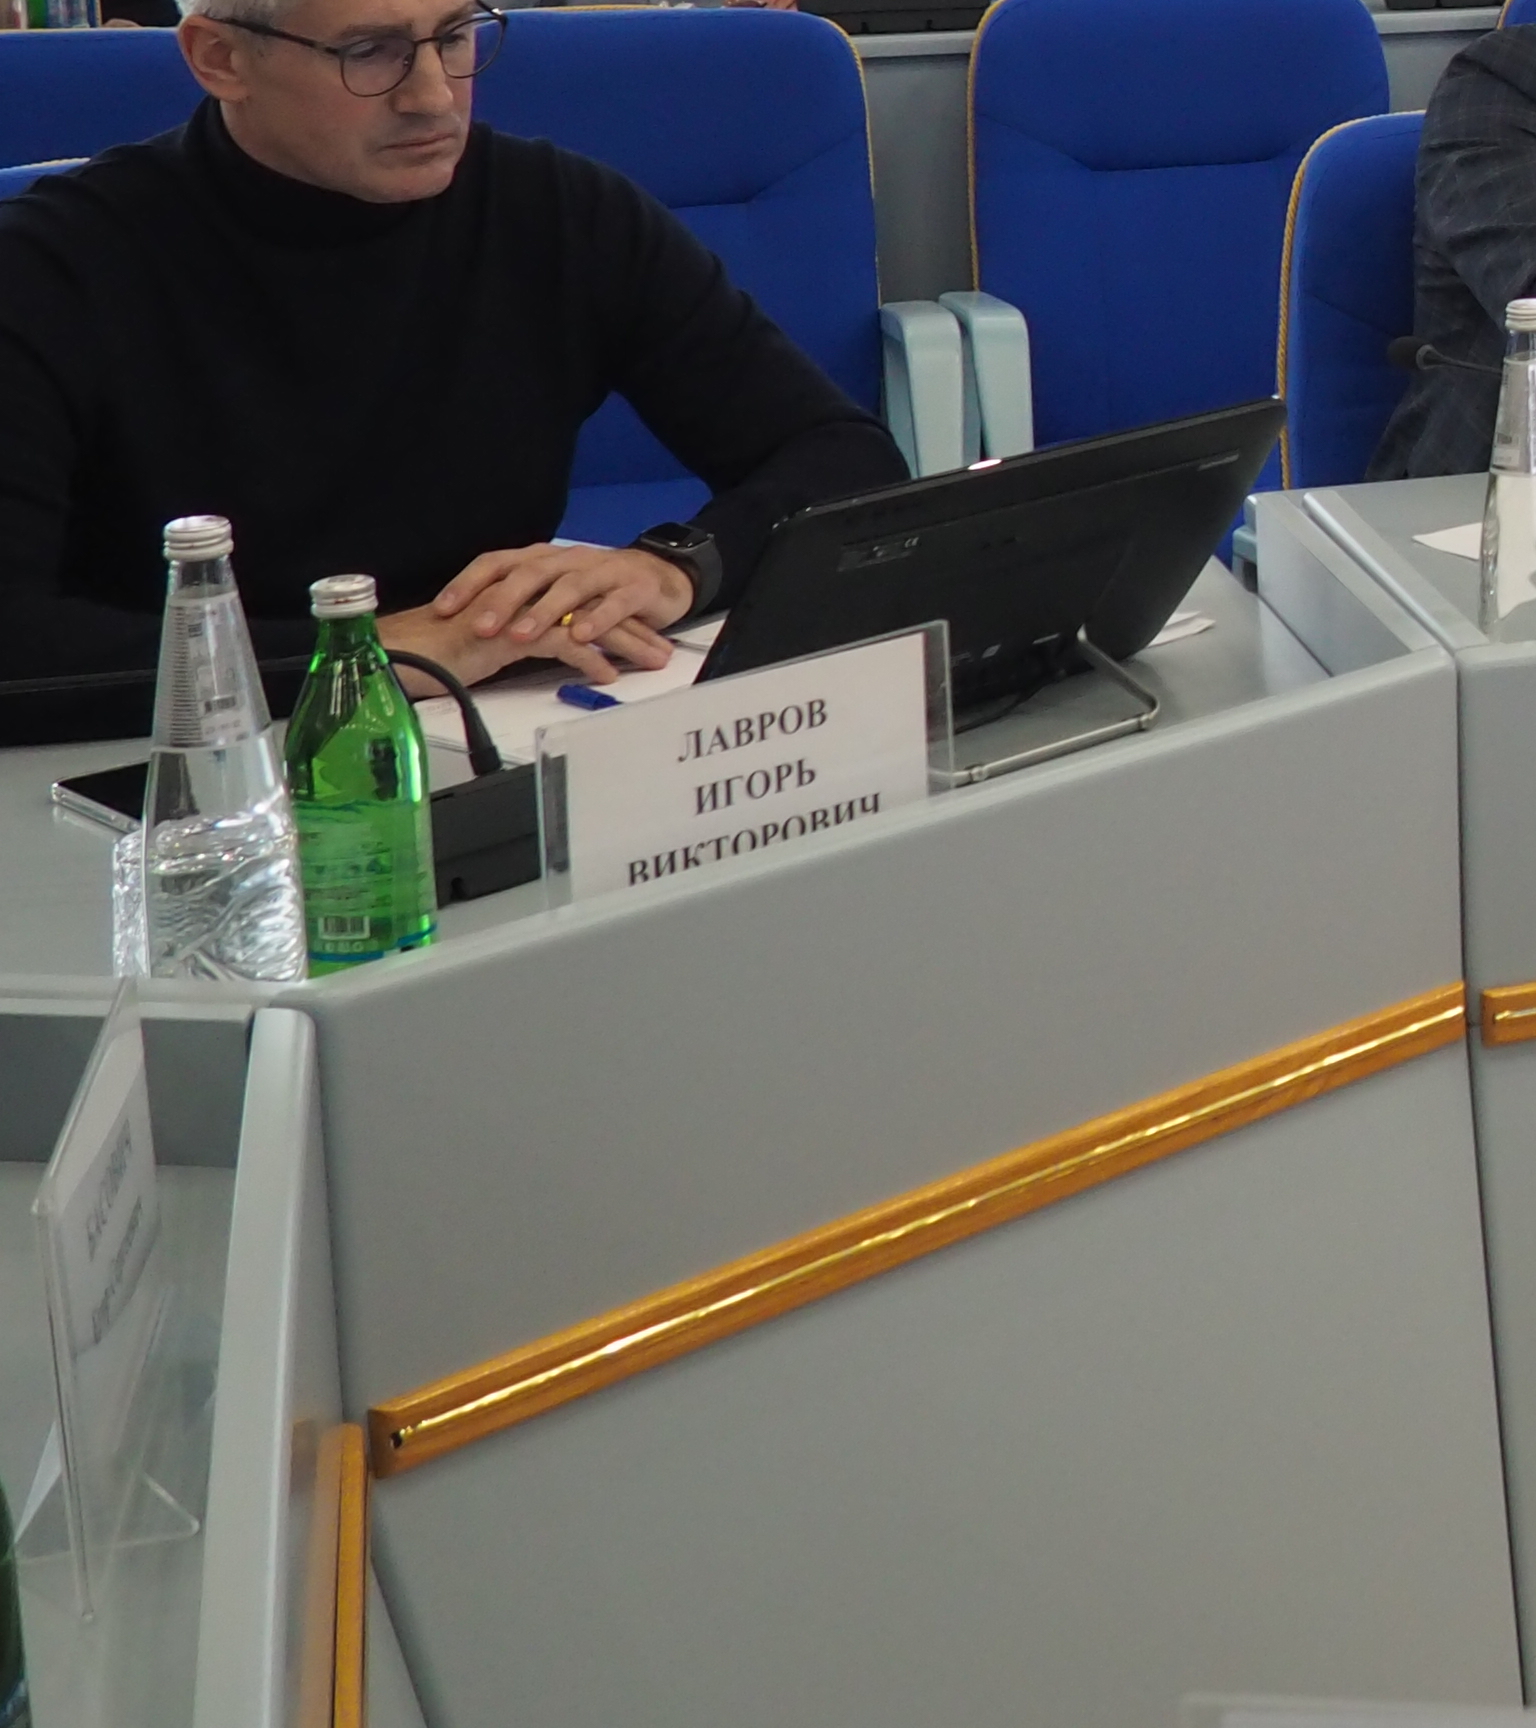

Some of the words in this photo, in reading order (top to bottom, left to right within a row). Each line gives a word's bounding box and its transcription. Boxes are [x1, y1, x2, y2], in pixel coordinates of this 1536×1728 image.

[677, 698, 828, 763] ЛАВРОВ
[694, 758, 817, 815] ИГОРЬ
[627, 792, 882, 886] ВИКТОРОВИЧ
